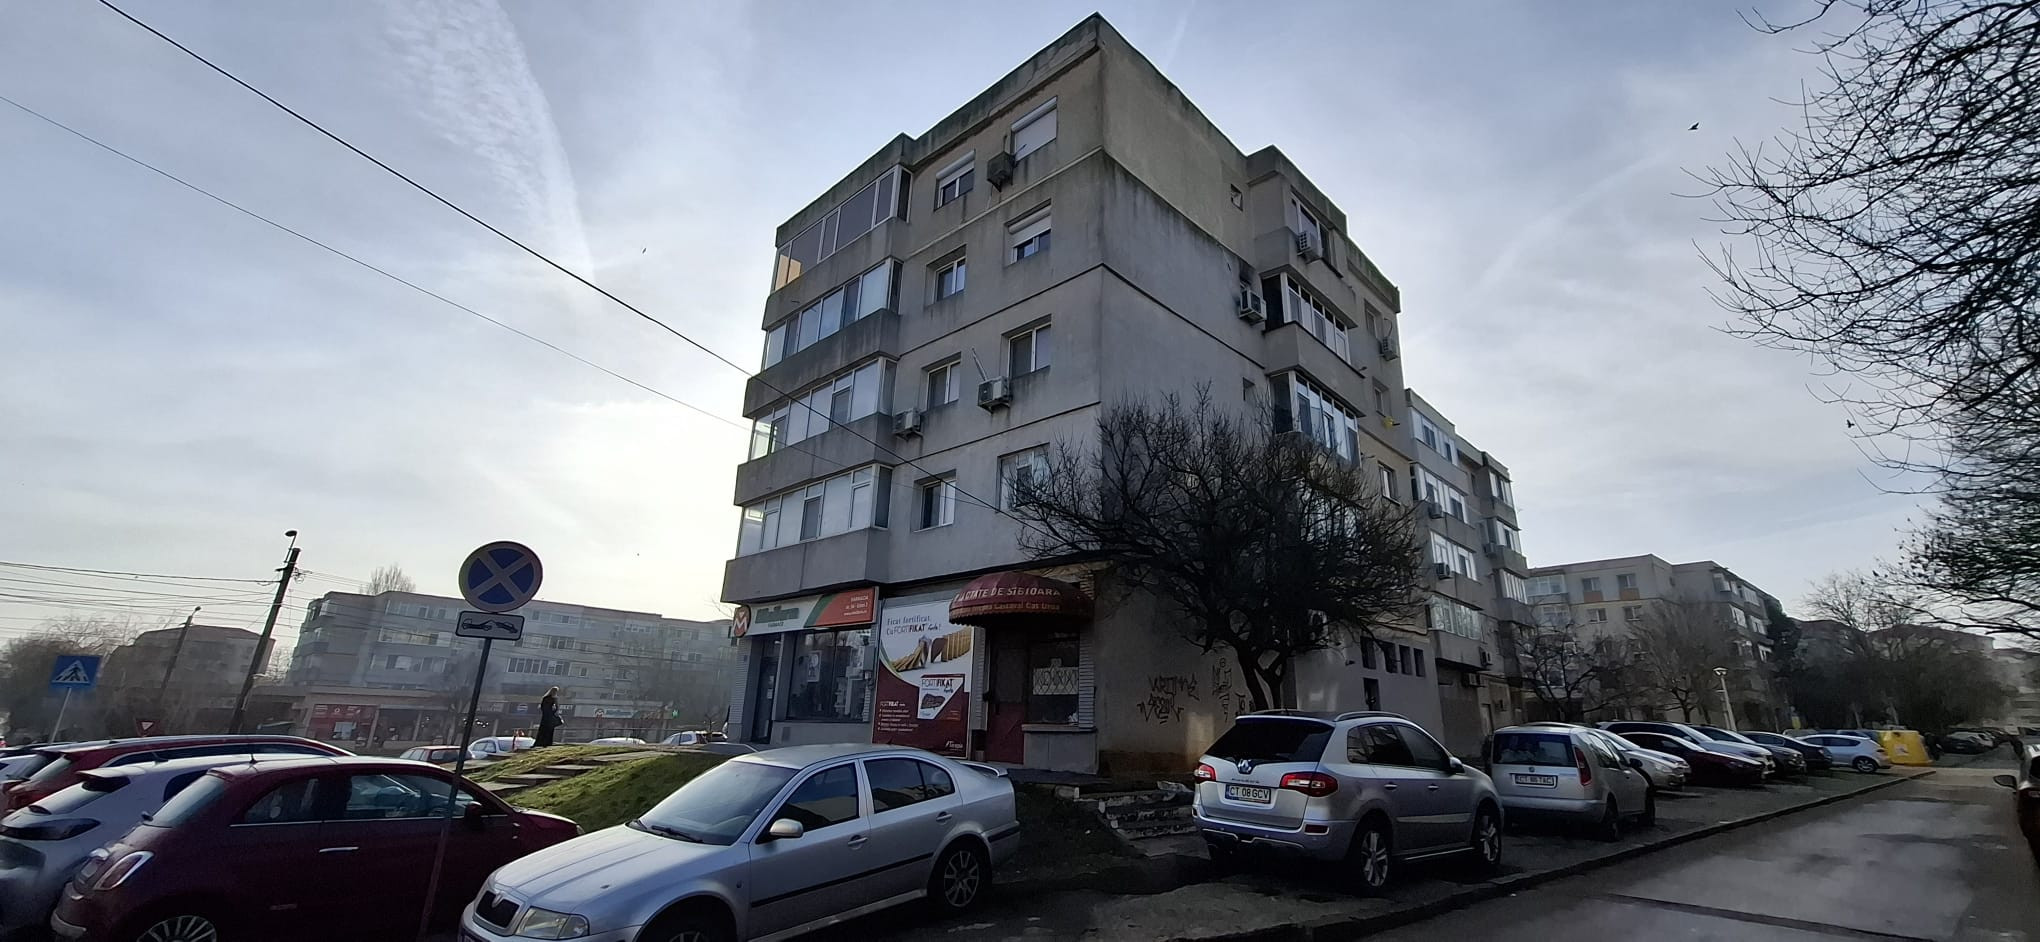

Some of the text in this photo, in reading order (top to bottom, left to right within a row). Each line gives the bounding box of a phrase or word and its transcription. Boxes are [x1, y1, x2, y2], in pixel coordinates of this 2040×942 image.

[990, 587, 1005, 596] DE
[1230, 786, 1269, 799] CT 08 GCV
